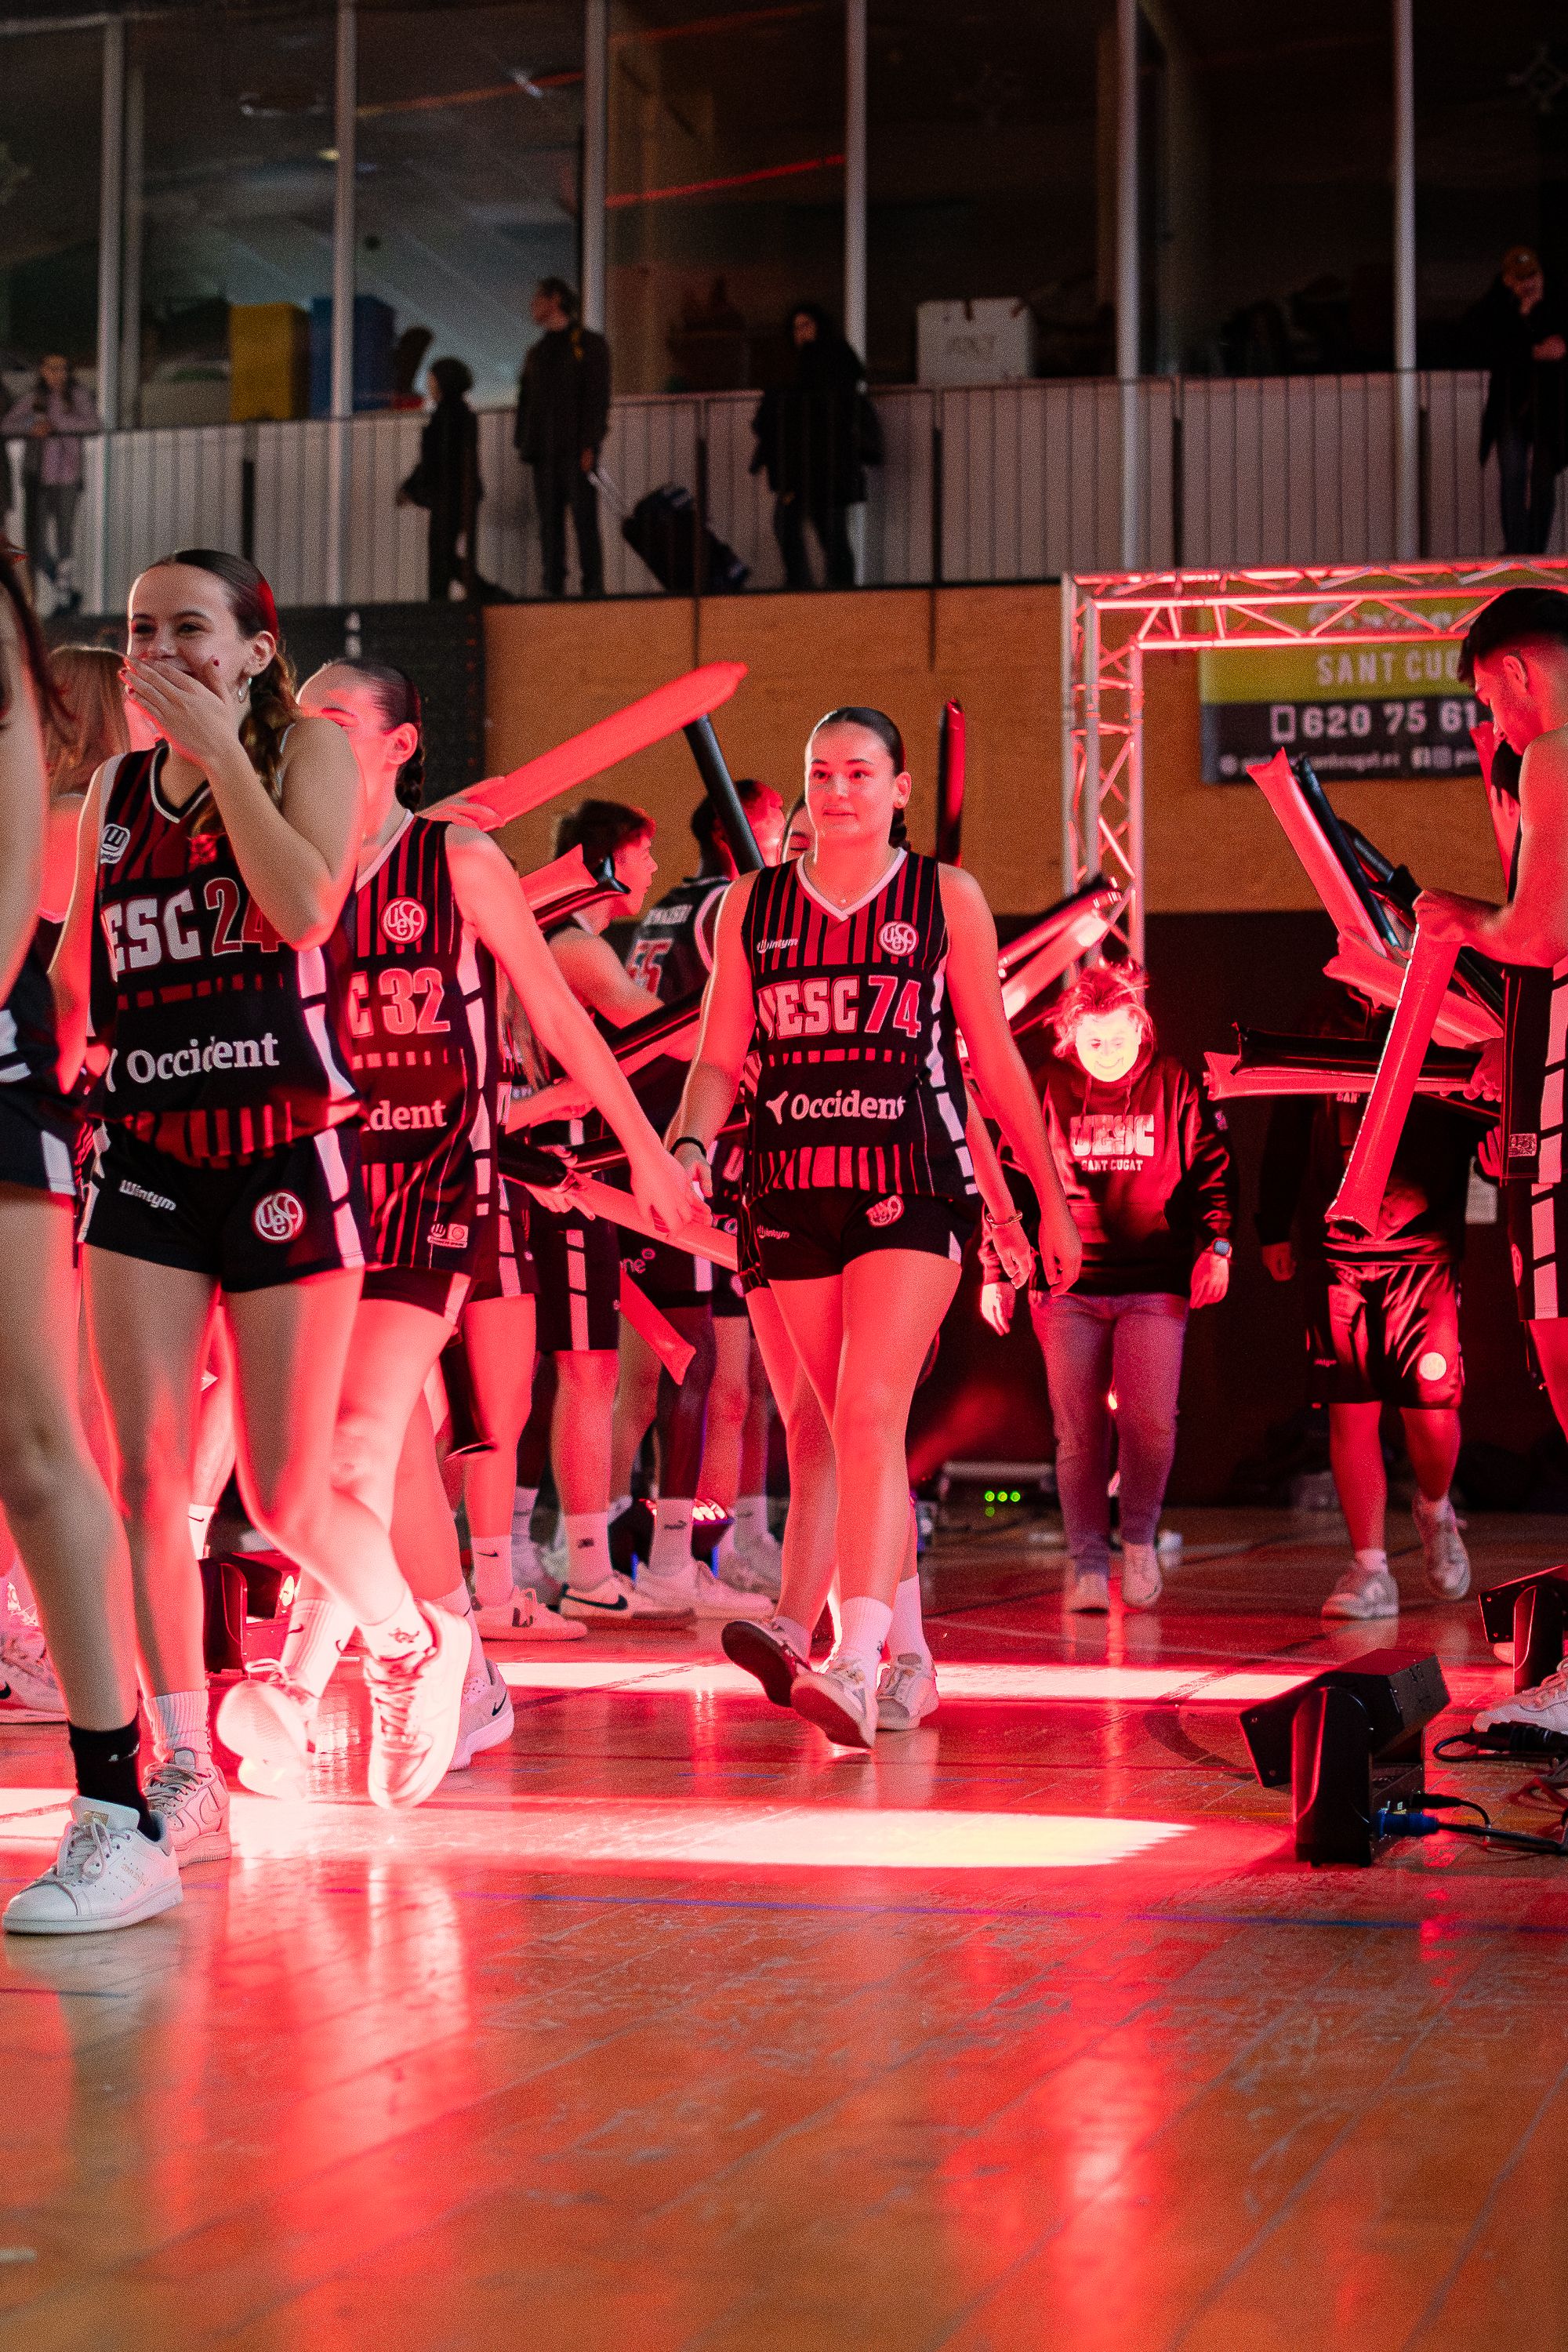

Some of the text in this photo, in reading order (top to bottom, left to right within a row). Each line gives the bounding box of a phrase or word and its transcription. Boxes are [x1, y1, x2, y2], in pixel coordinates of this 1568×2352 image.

[1316, 649, 1461, 687] SANT CUG
[1301, 699, 1478, 739] 620 75 61
[100, 888, 201, 982] ESC
[379, 967, 451, 1035] 32
[864, 975, 922, 1039] 74
[791, 1089, 906, 1120] Occident
[1081, 1158, 1143, 1171] SANT CUGAT
